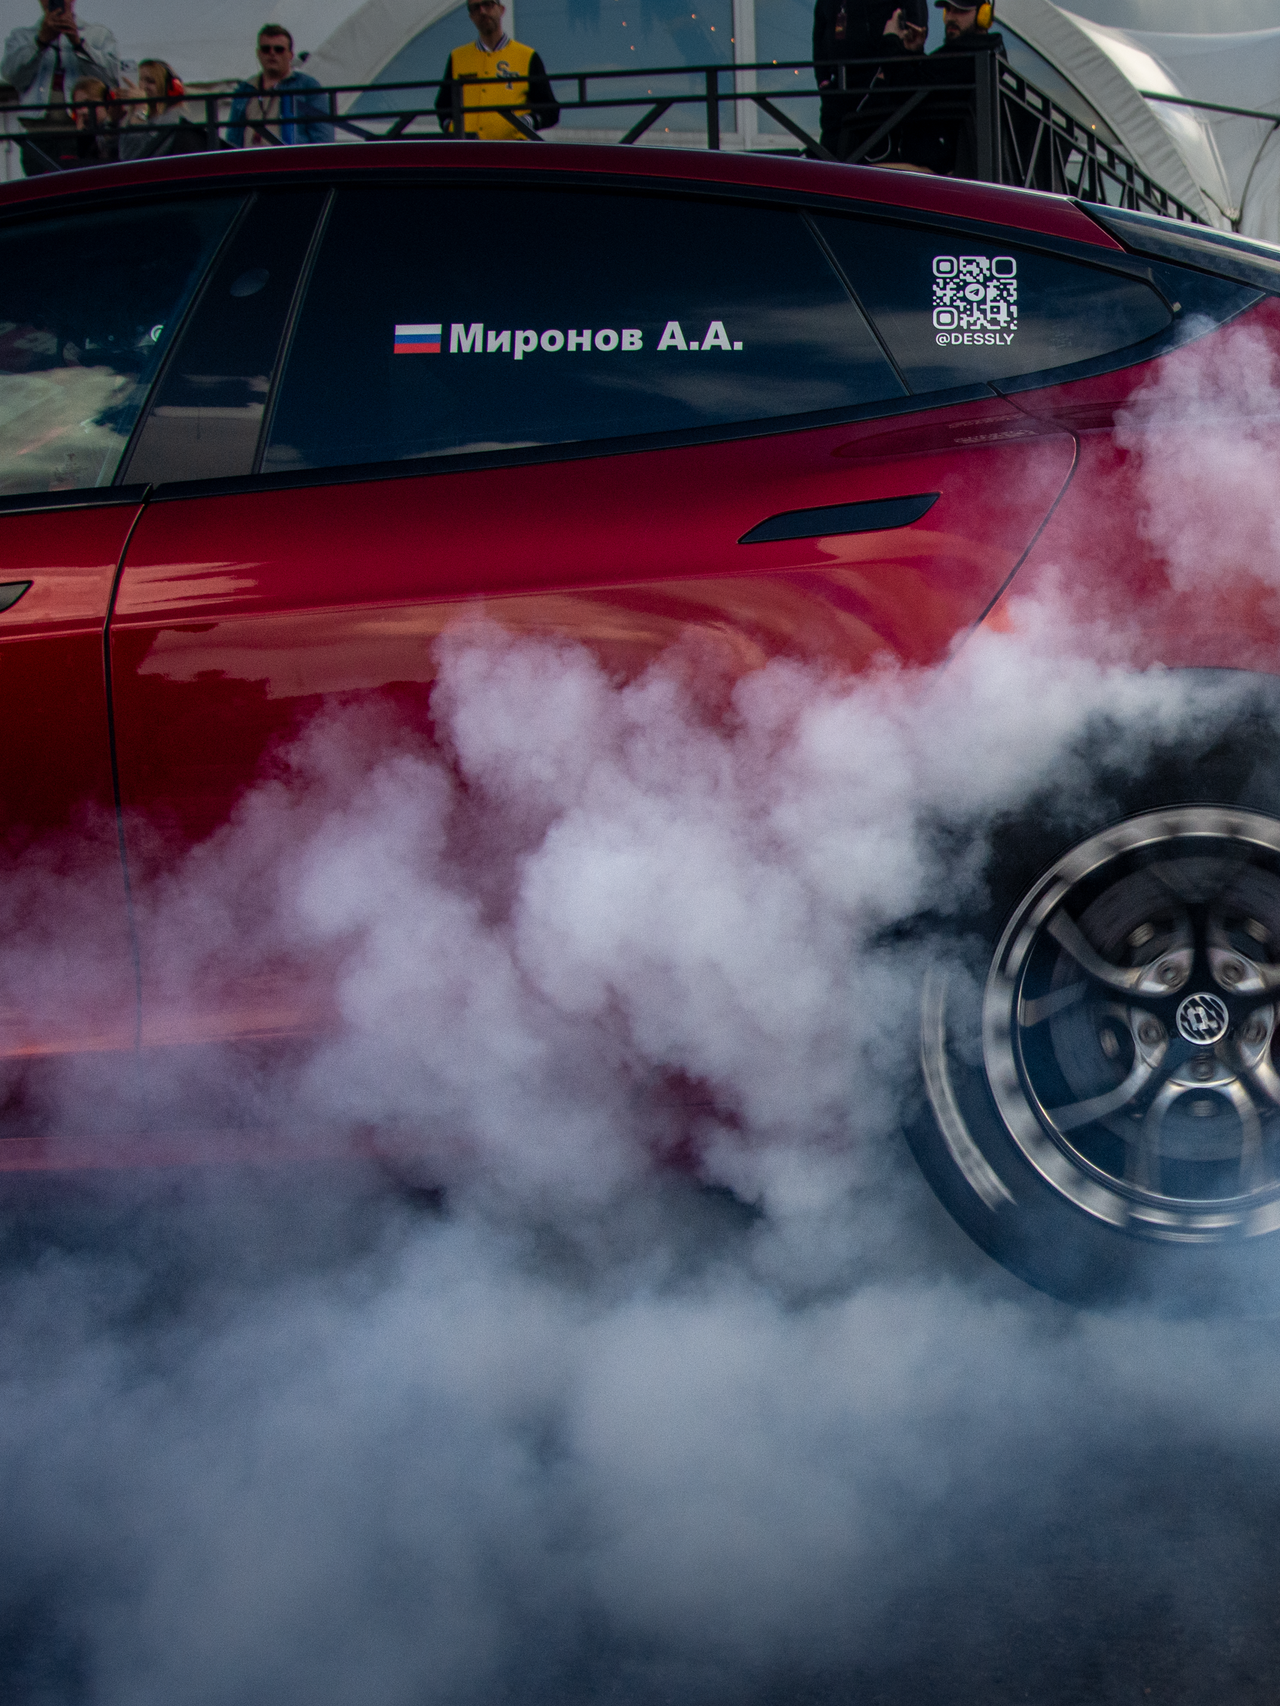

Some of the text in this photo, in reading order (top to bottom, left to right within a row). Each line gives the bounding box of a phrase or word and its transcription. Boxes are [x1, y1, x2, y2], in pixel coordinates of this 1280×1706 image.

[449, 320, 744, 361] Миронов А.А.
[935, 332, 1015, 346] @DESSLY
